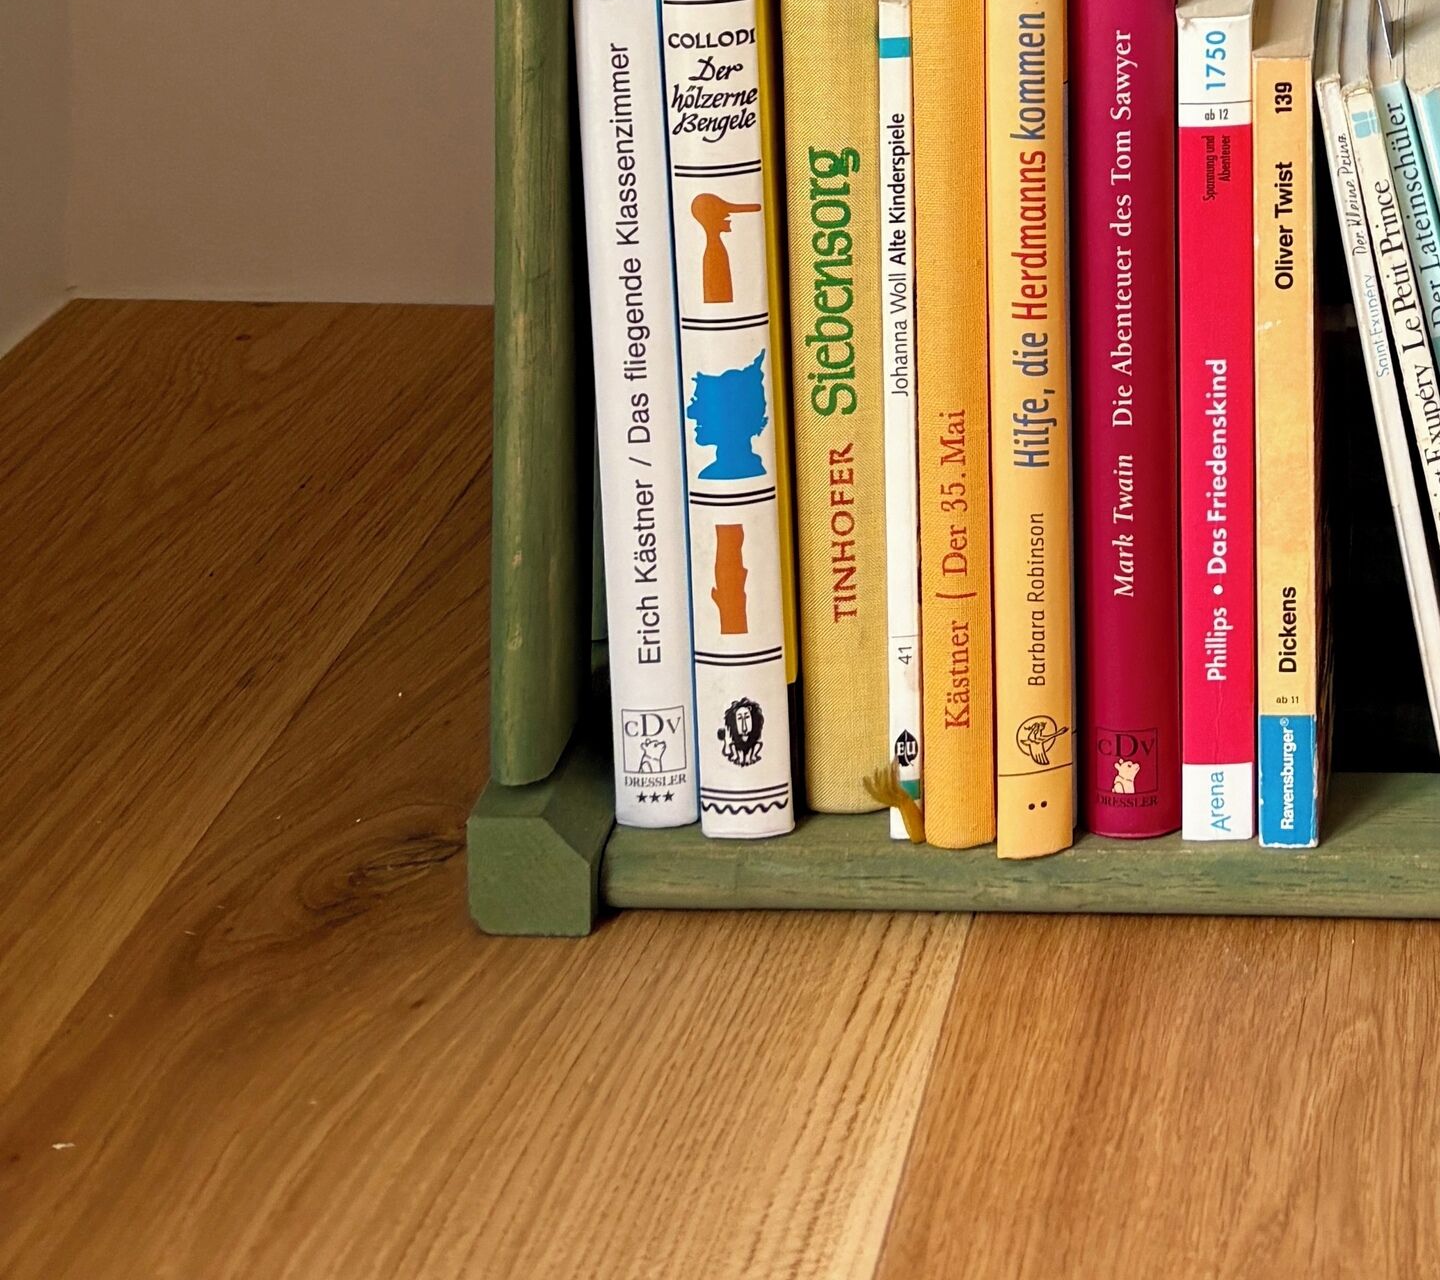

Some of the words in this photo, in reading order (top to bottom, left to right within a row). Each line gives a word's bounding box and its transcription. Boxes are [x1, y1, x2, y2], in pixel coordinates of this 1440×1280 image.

[668, 27, 756, 49] COLLODI
[1205, 30, 1227, 91] 1750
[688, 56, 743, 81] Der
[1009, 11, 1046, 141] kommen
[1110, 30, 1138, 121] Sawyer
[671, 84, 758, 113] hölzerne
[672, 107, 757, 143] Bengele
[1204, 108, 1216, 120] ab
[1219, 108, 1229, 120] 12
[1274, 82, 1293, 114] 139
[609, 42, 640, 246] Klassenzimmer
[886, 112, 910, 221] Kinderspiele
[1110, 129, 1132, 186] Tom
[1201, 135, 1216, 154] und
[1218, 135, 1231, 182] Abenteuer
[1202, 155, 1218, 201] Spannung
[1274, 161, 1293, 218] Twist
[1386, 101, 1440, 277] Lateinschüler
[888, 224, 907, 265] Alte
[1011, 150, 1048, 320] Herdmanns
[1110, 194, 1133, 238] des
[1374, 178, 1404, 256] Prince
[806, 146, 861, 416] Siebensorg
[1274, 224, 1294, 290] Oliver
[890, 273, 907, 315] Woll
[1110, 245, 1134, 377] Abenteuer
[1386, 258, 1416, 315] Petit
[618, 258, 650, 382] fliegende
[1403, 316, 1425, 355] Le
[891, 319, 908, 397] Johanna
[1012, 331, 1049, 377] die
[627, 392, 651, 445] Das
[1013, 388, 1057, 469] Hilfe,
[1111, 384, 1134, 427] Die
[938, 410, 966, 466] Mai
[1205, 358, 1229, 521] Friedenskind
[941, 472, 968, 512] 35.
[1112, 453, 1135, 523] Twain
[631, 479, 657, 583] Kästner
[829, 442, 859, 625] TINHOFER
[942, 524, 968, 577] Der
[1026, 512, 1045, 603] Robinson
[1207, 527, 1228, 575] Das
[1112, 532, 1135, 598] Mark
[636, 589, 662, 664] Erich
[1027, 608, 1046, 687] Barbara
[1204, 606, 1234, 683] Phillips
[1277, 586, 1297, 673] Dickens
[898, 646, 913, 665] 41
[944, 620, 970, 730] Kästner
[1276, 696, 1288, 704] ab
[1291, 695, 1299, 704] 11
[624, 773, 687, 788] DRESSLER
[1096, 791, 1159, 808] DRESSLER
[1210, 770, 1233, 833] Arena
